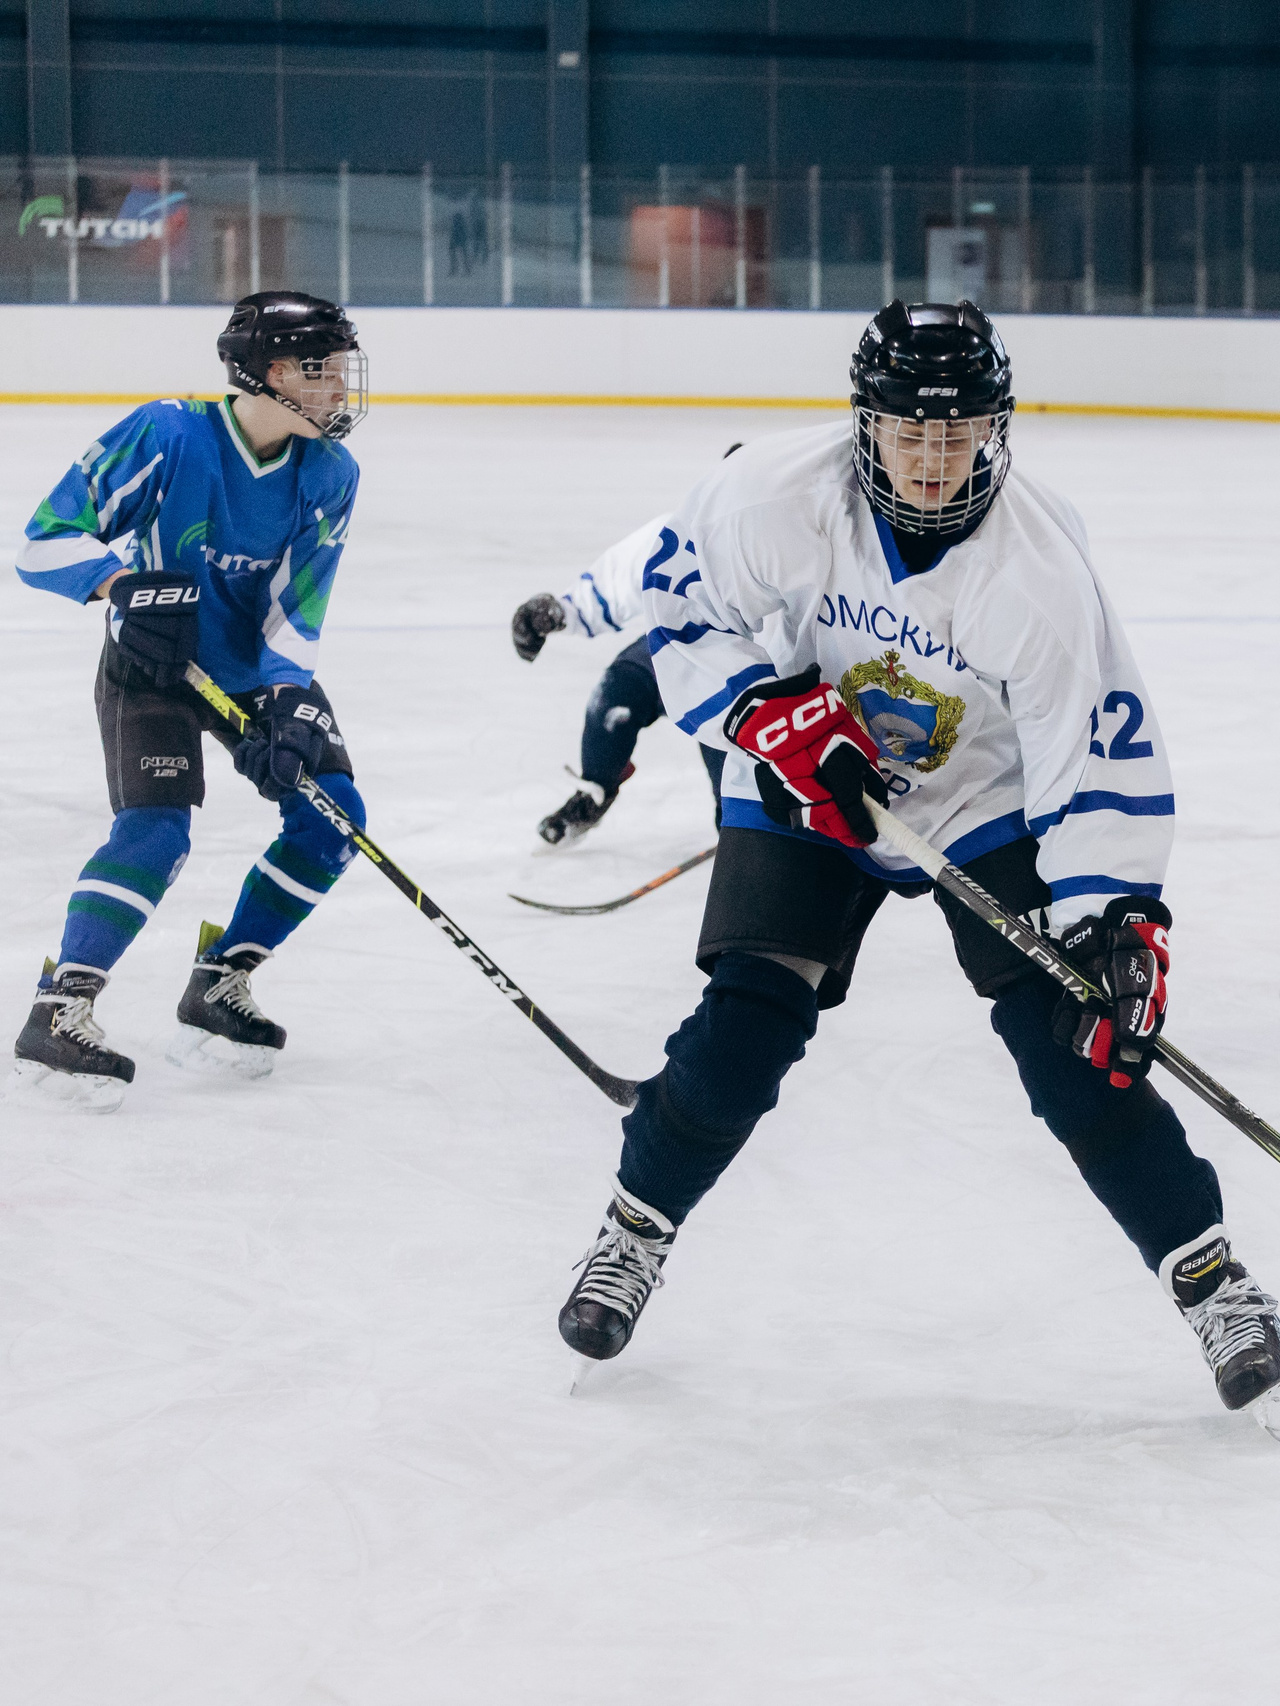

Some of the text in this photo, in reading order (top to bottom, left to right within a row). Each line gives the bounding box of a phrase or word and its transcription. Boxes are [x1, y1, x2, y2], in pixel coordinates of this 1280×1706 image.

[917, 387, 959, 397] EFSI
[130, 585, 200, 608] BAU
[140, 756, 189, 770] NRG
[1065, 926, 1092, 950] CCM
[431, 911, 524, 1001] CCM
[988, 918, 1090, 1004] ALPHA
[1128, 956, 1138, 977] PRO
[1128, 999, 1143, 1032] CCM
[1182, 1242, 1223, 1273] BAUER
